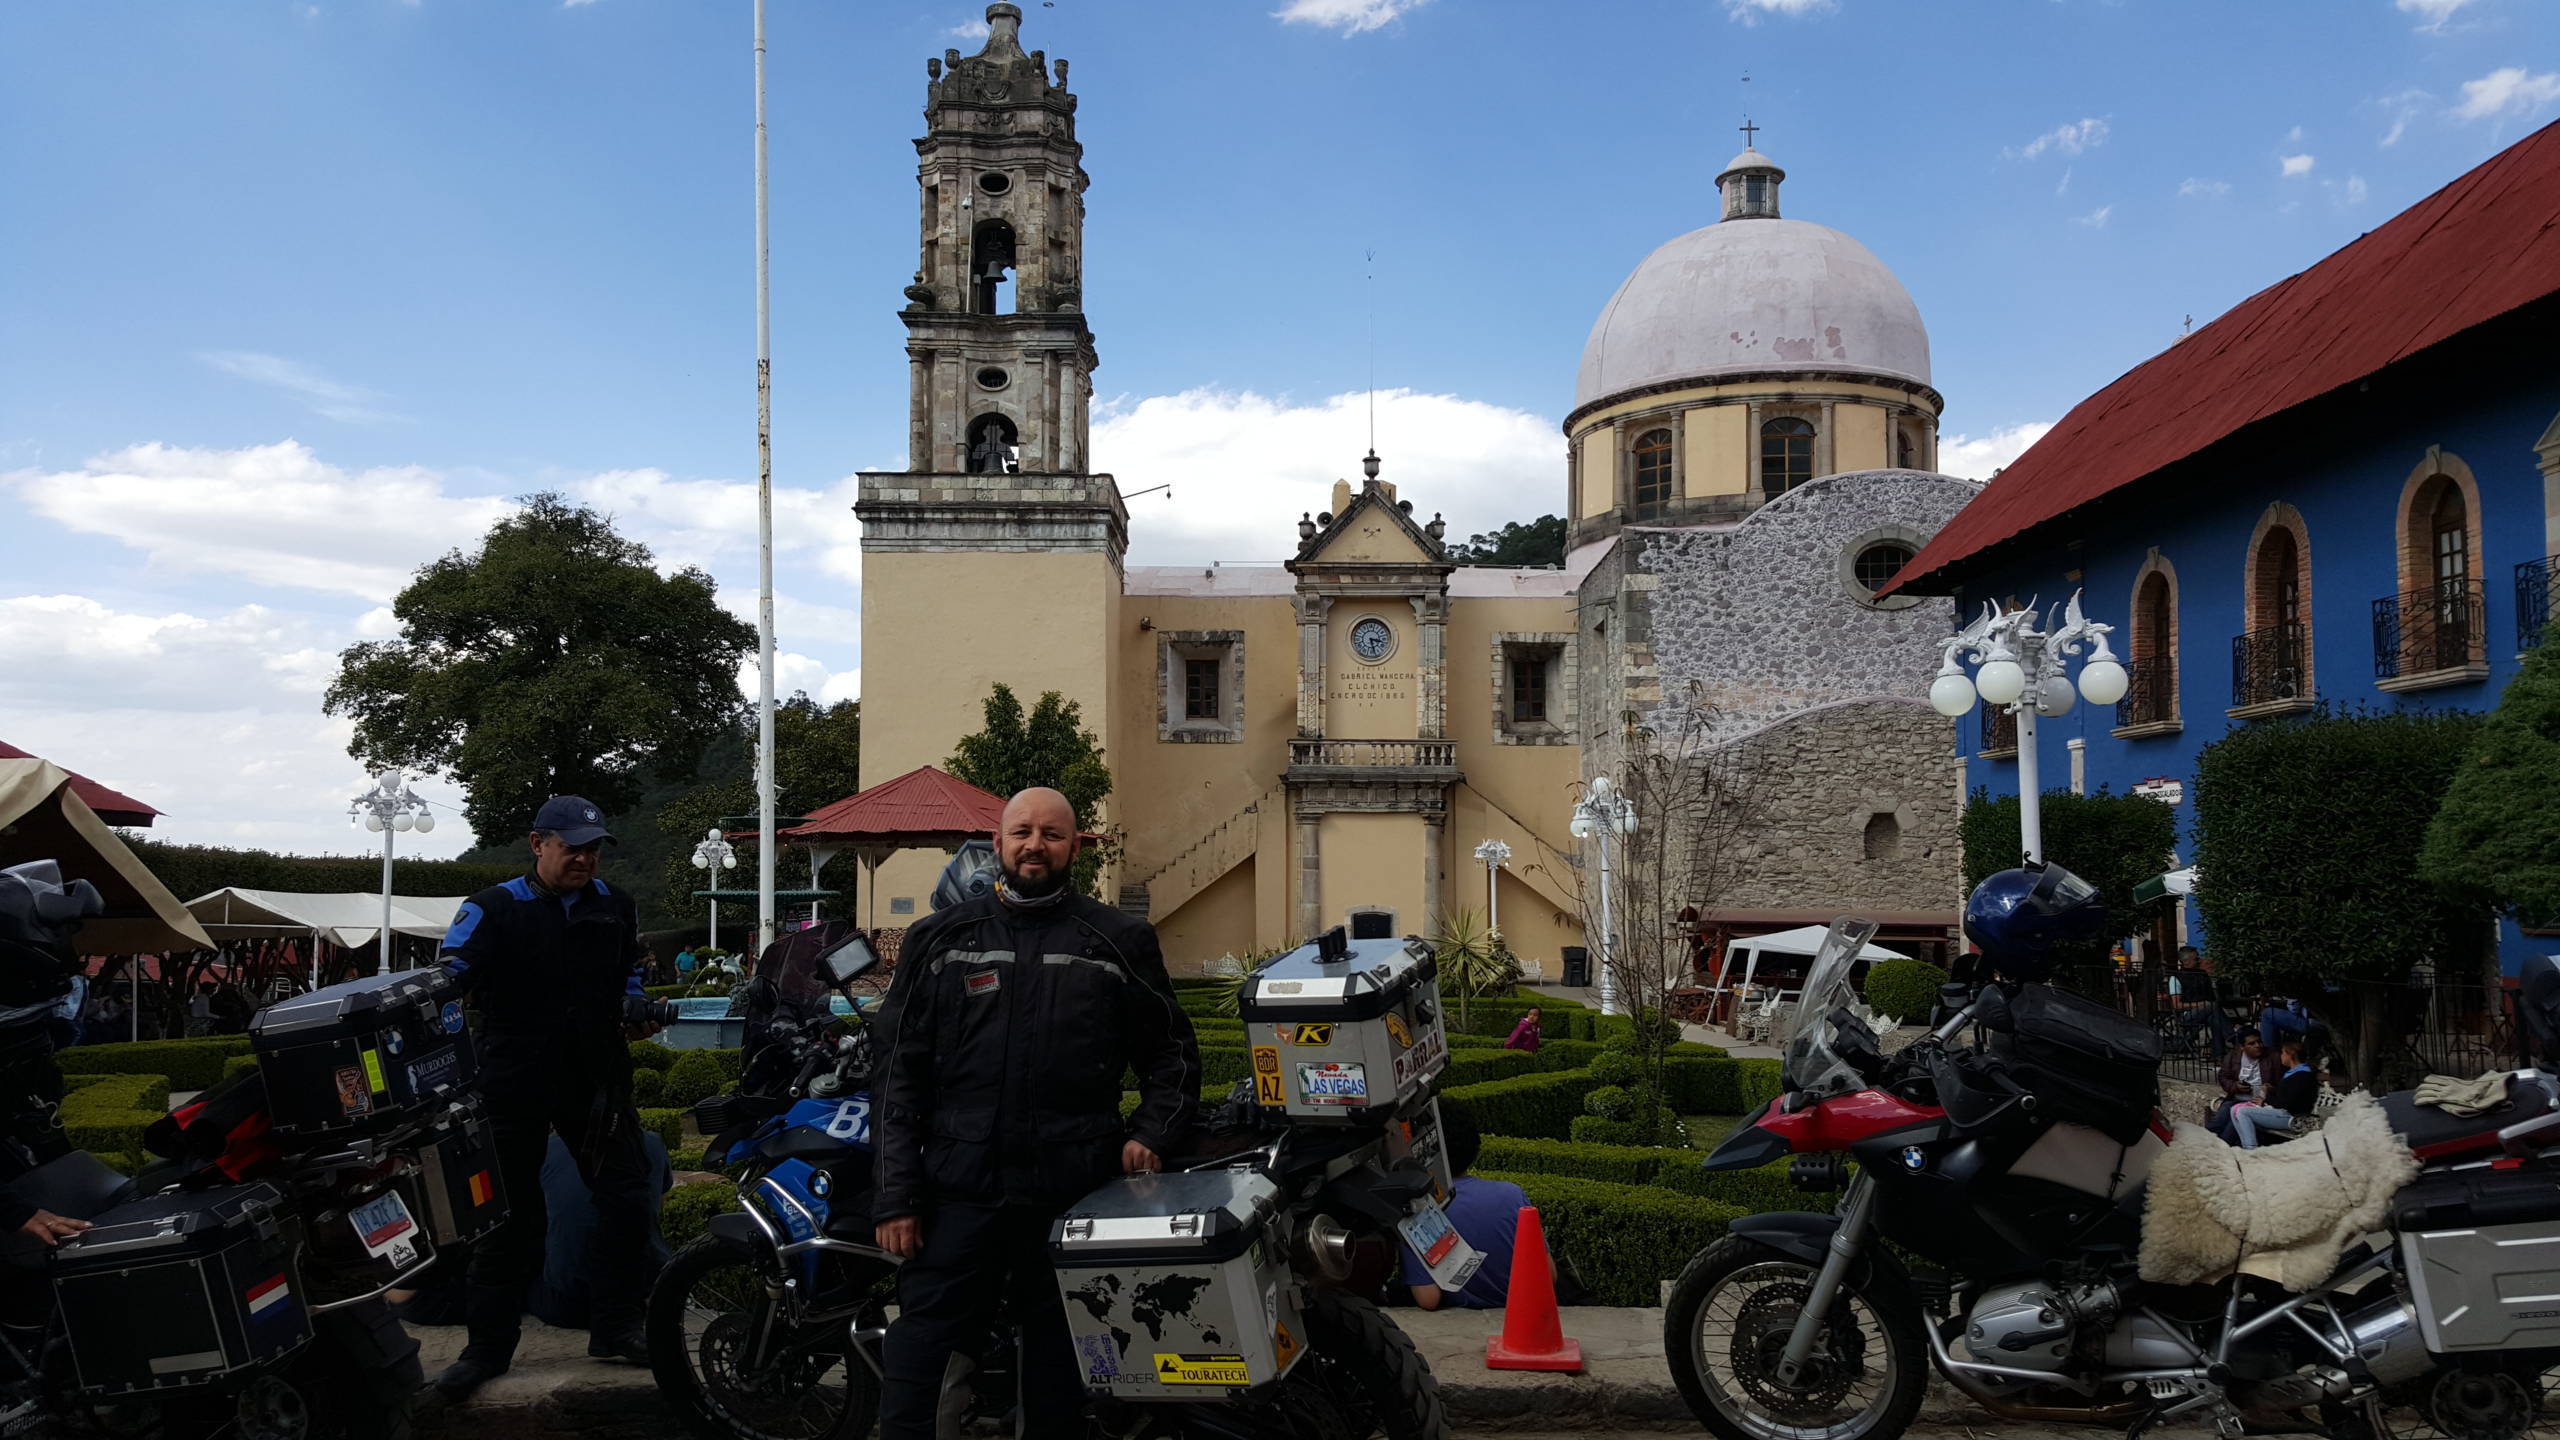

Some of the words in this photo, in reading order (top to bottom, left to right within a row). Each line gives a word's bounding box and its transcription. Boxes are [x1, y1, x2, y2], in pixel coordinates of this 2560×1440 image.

[443, 1011, 462, 1024] NASA
[1297, 1026, 1330, 1043] K
[1258, 1057, 1276, 1071] BDR
[1395, 1031, 1442, 1085] PARRAL
[1261, 1076, 1283, 1102] AZ
[1308, 1078, 1328, 1094] LAS
[1328, 1078, 1365, 1095] VEGAS
[1089, 1373, 1155, 1384] ALTRIDER
[1180, 1369, 1247, 1382] TOURATECH
